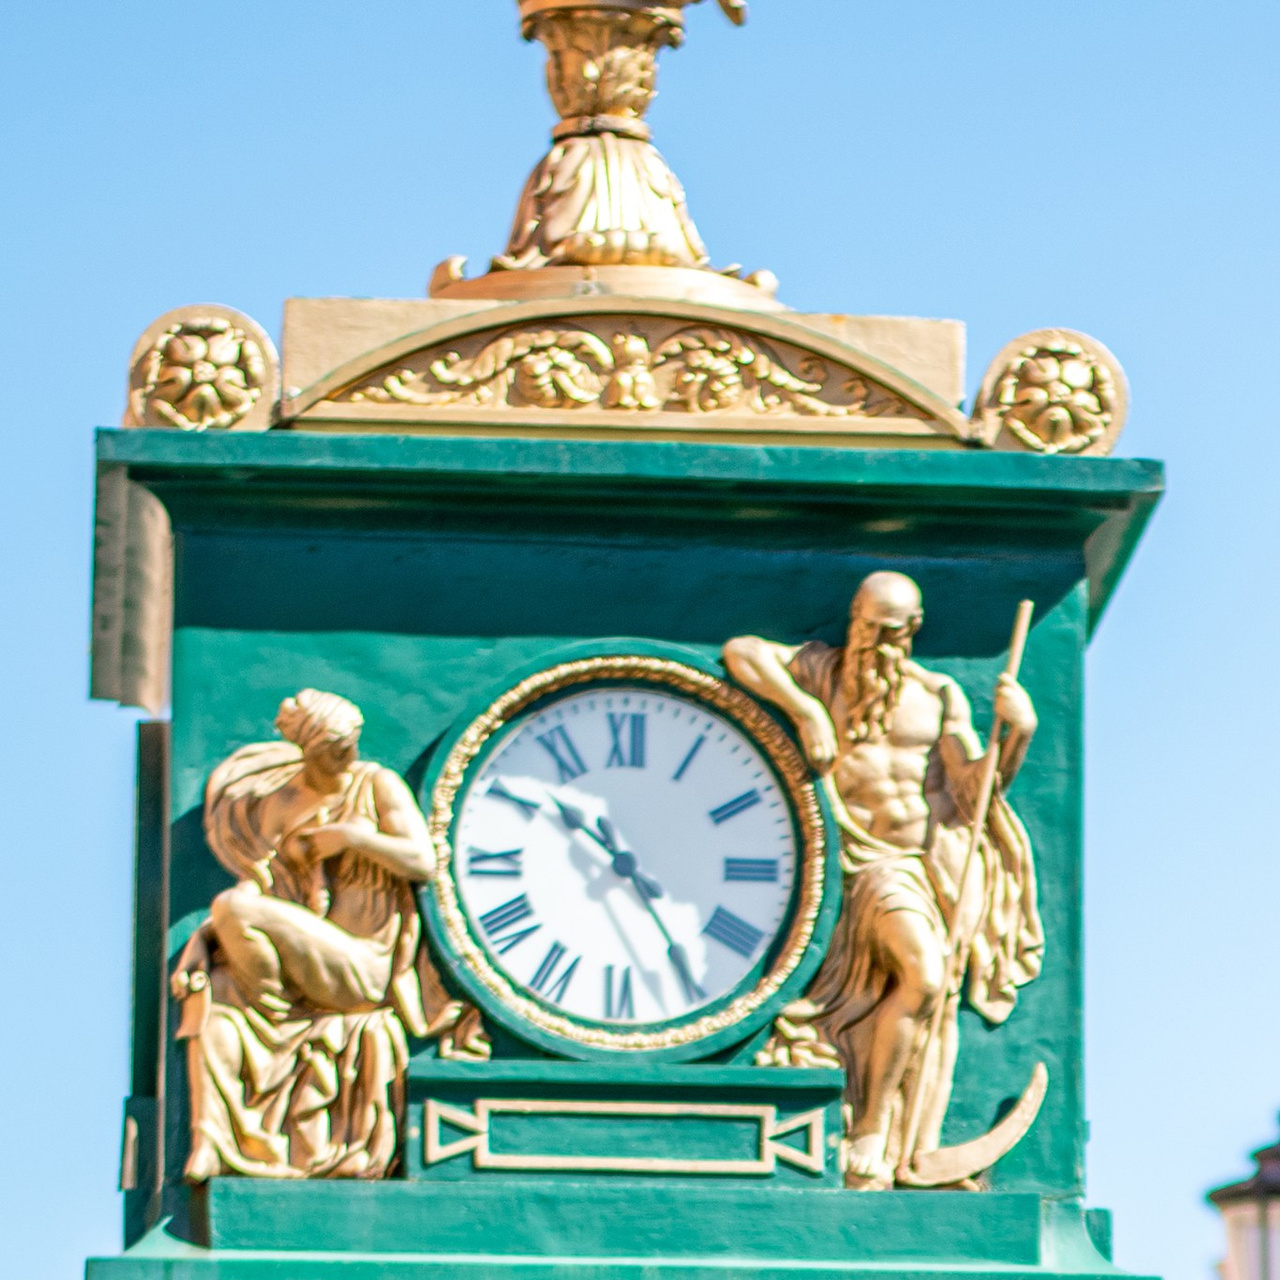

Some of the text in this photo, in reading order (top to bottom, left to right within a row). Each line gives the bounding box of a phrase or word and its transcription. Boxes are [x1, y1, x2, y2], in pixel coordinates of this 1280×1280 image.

[535, 723, 589, 785] XI
[605, 712, 647, 769] XII
[484, 777, 541, 824] X
[708, 787, 763, 826] II
[467, 845, 524, 877] IX
[723, 856, 779, 883] III
[478, 892, 543, 956] VIII
[528, 940, 583, 1004] VII
[603, 964, 636, 1019] VI
